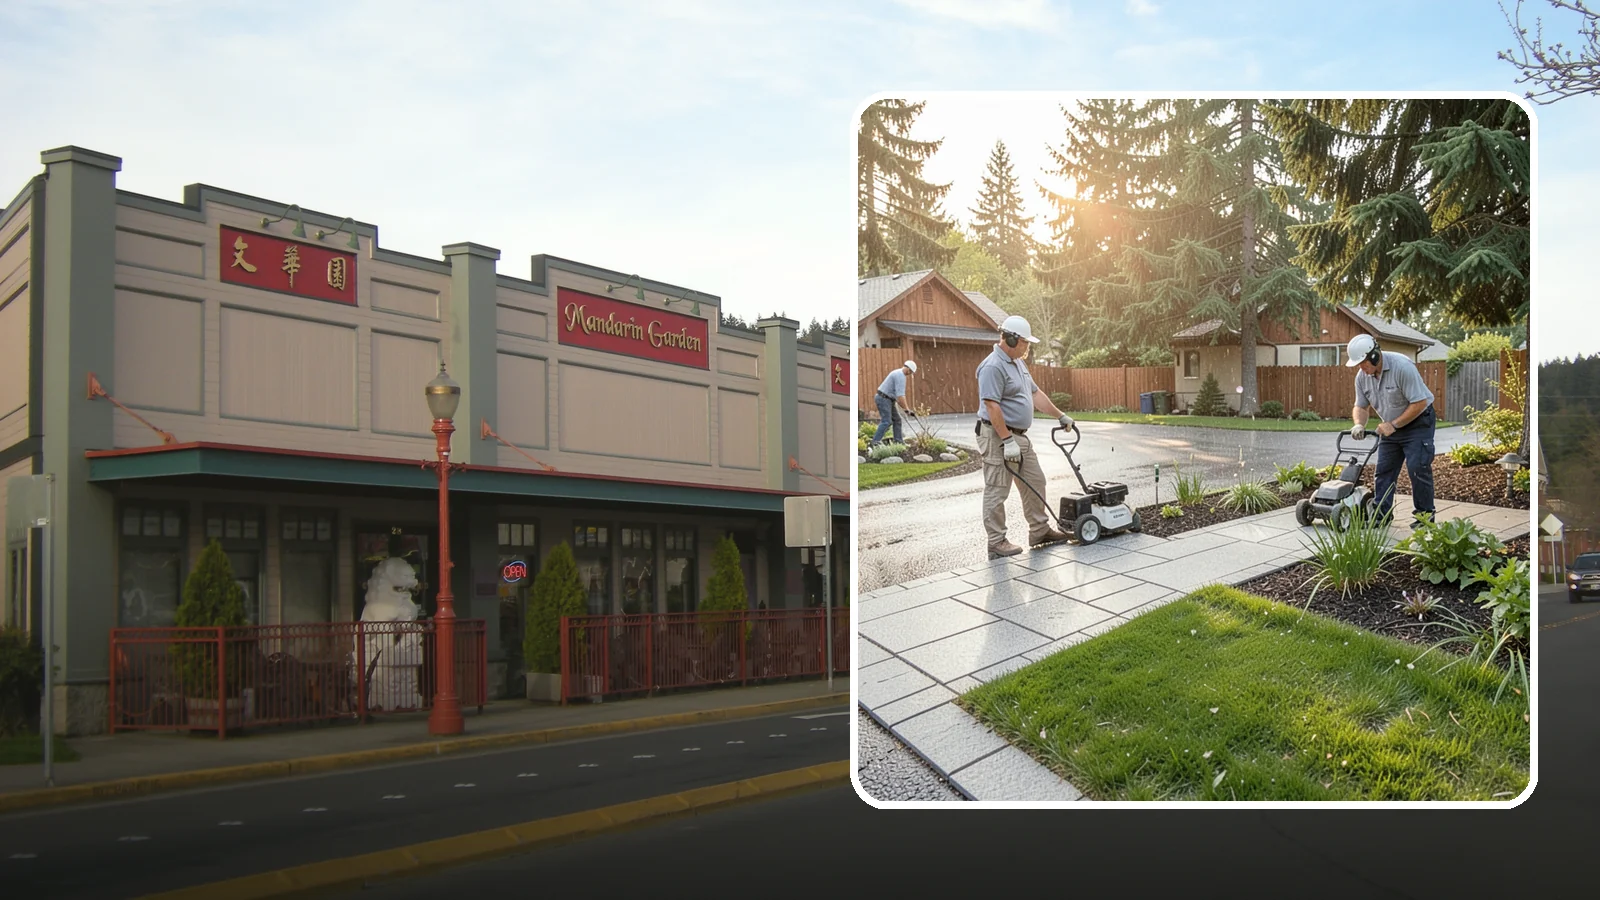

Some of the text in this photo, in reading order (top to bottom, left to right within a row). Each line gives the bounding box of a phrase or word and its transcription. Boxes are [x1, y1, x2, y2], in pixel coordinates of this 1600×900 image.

[231, 236, 346, 290] 文華園
[564, 302, 701, 351] Mandarin Garden
[503, 565, 526, 578] OPEN
